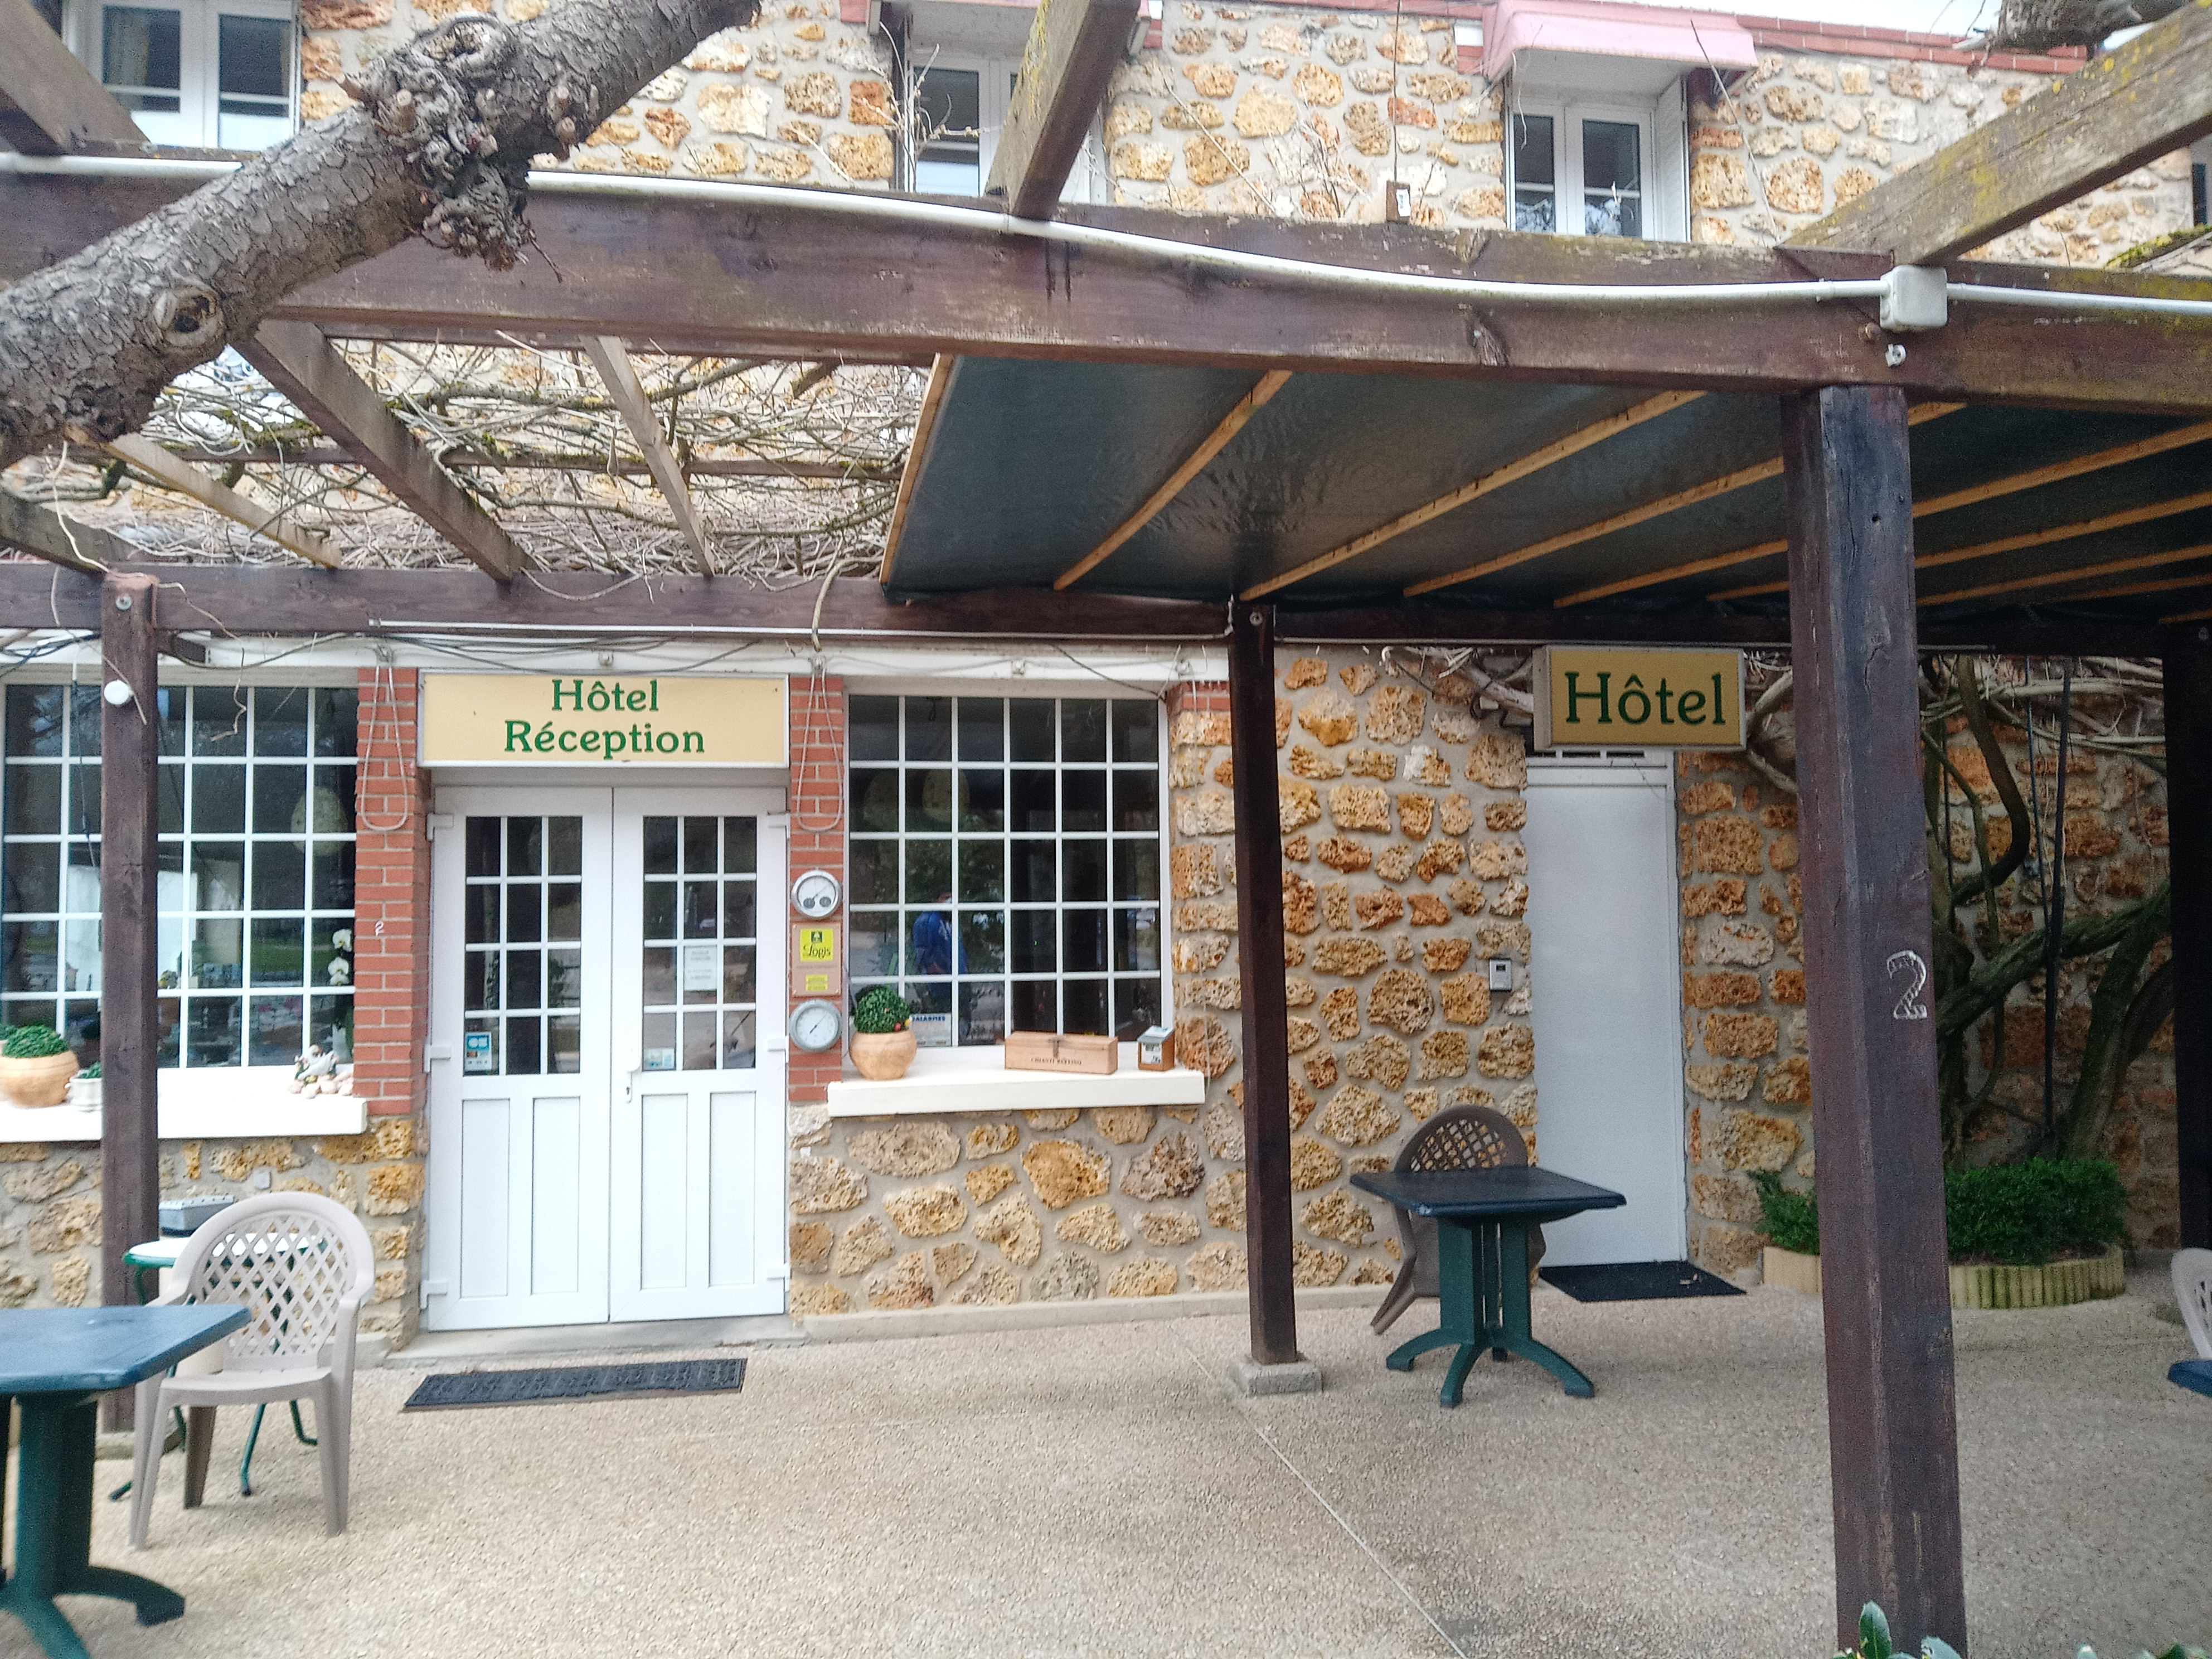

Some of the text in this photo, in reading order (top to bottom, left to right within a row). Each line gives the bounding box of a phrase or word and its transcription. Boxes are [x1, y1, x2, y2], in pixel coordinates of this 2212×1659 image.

[552, 680, 659, 711] Hôtel
[1564, 672, 1726, 725] Hôtel
[504, 720, 705, 760] Réception
[1886, 949, 1928, 1020] 2
